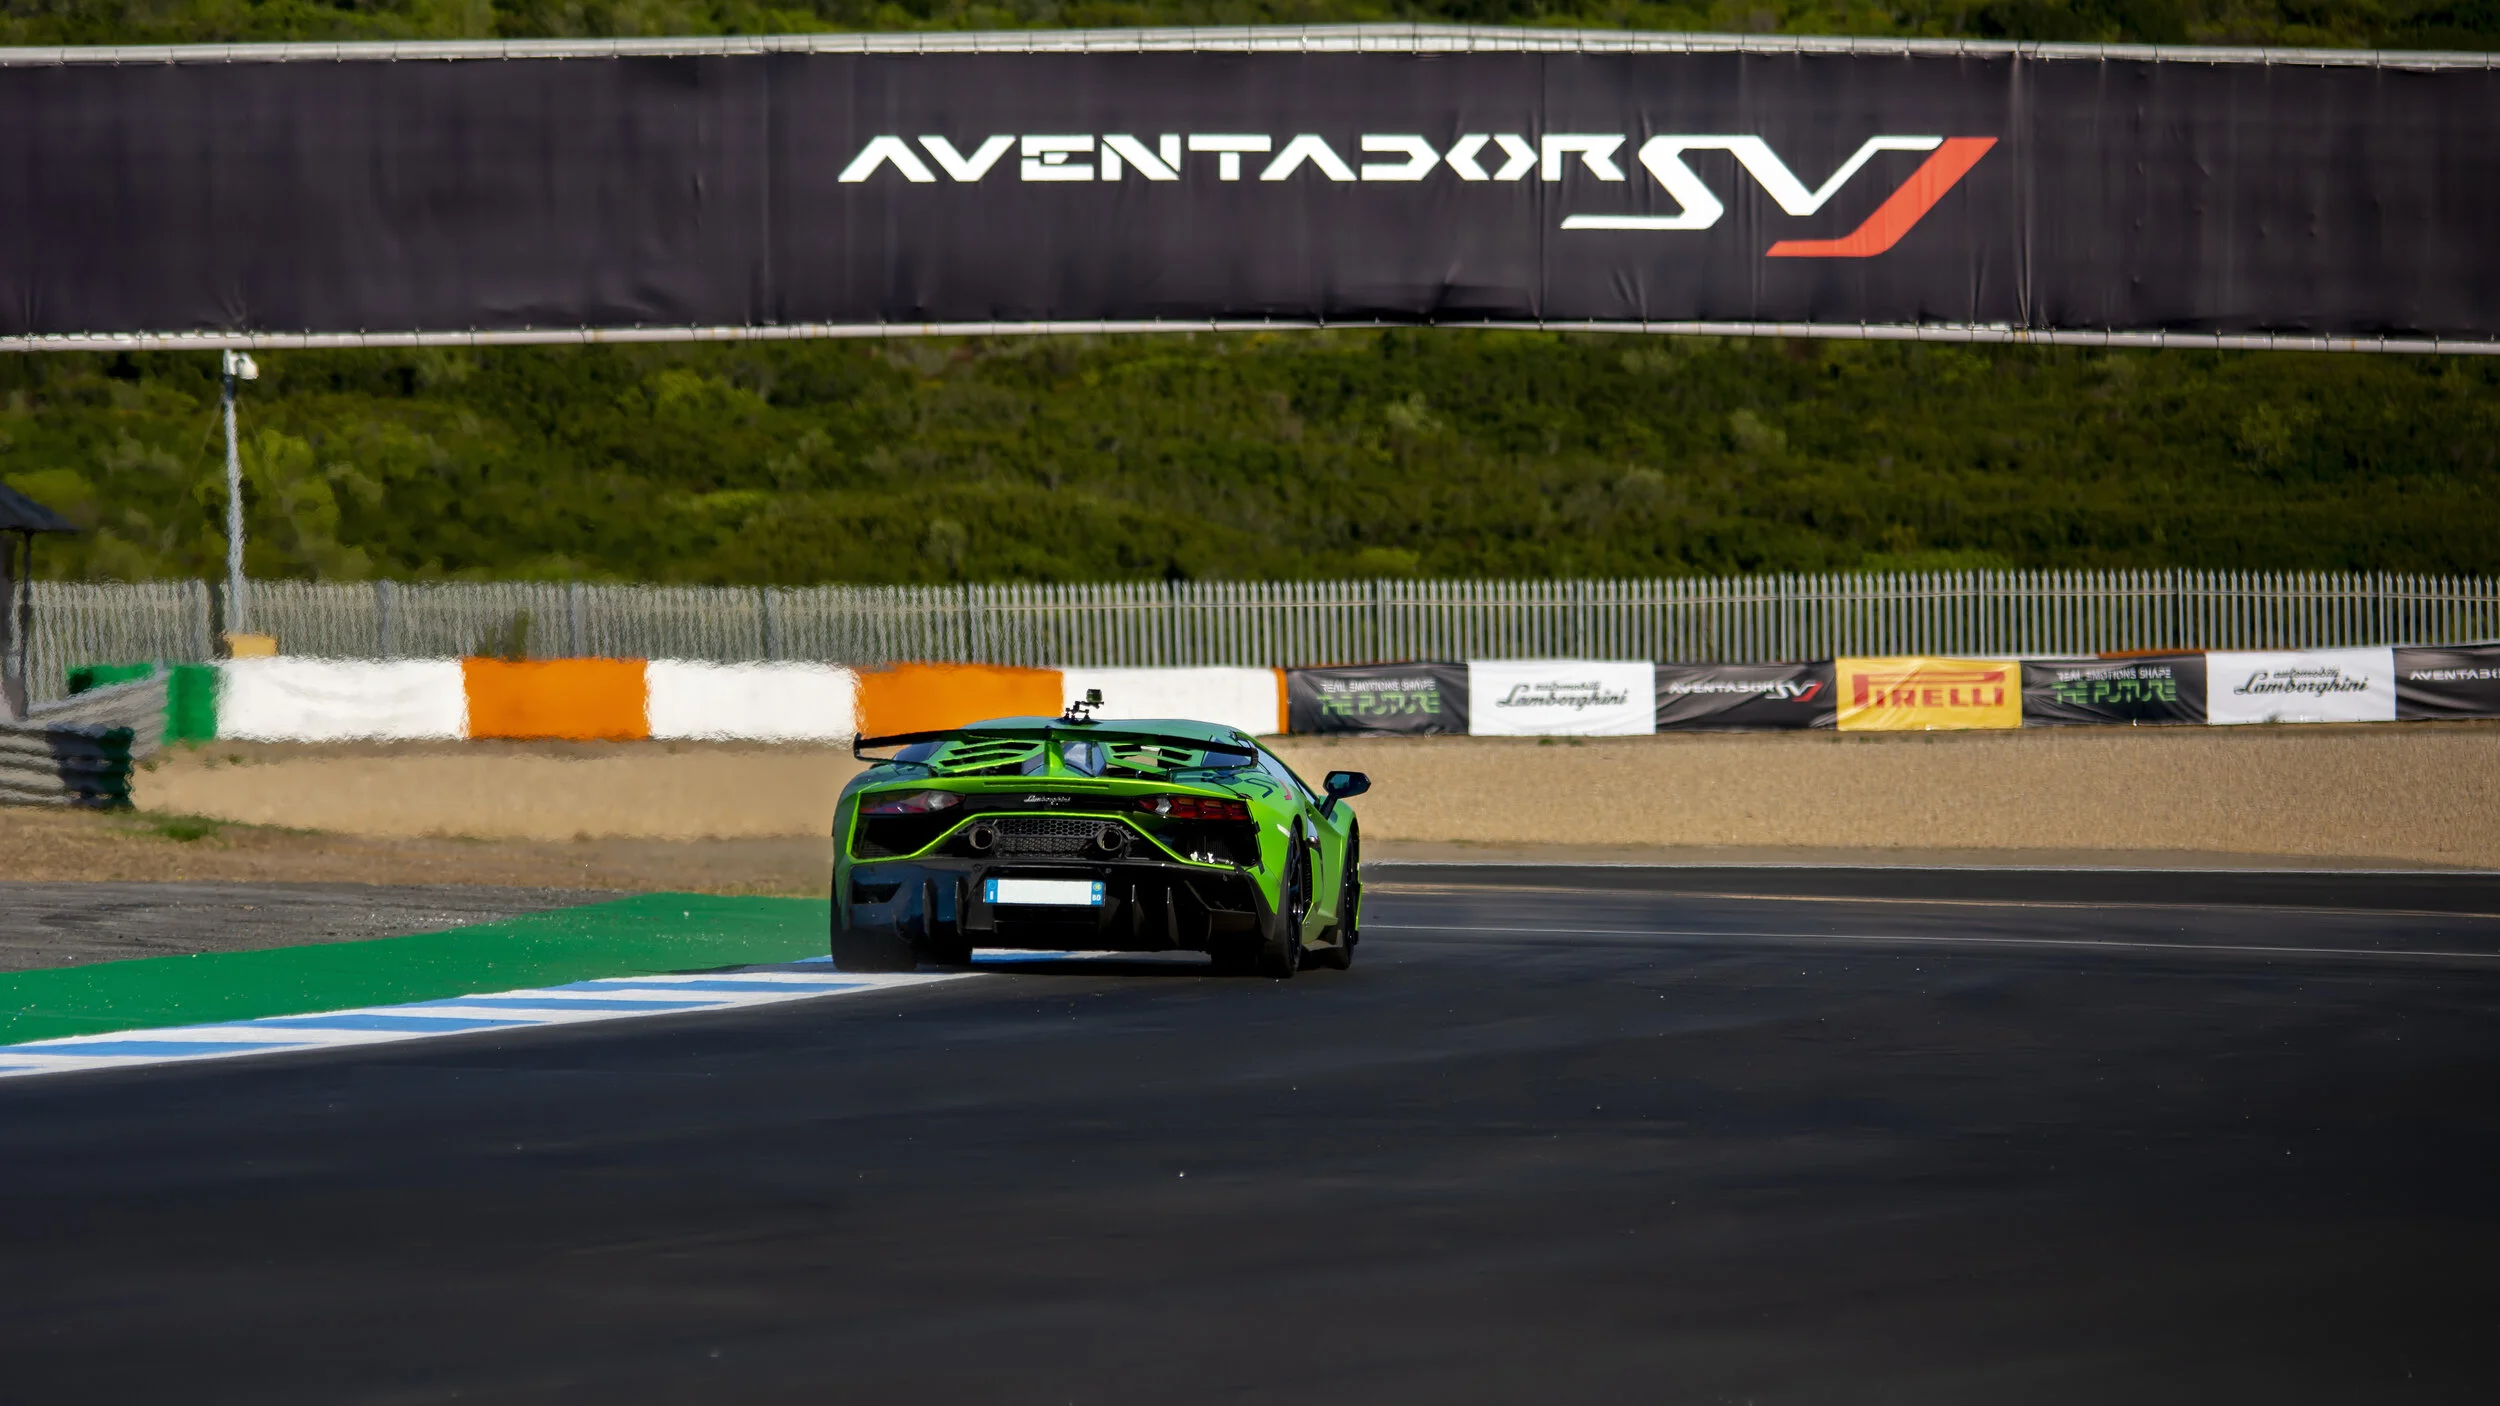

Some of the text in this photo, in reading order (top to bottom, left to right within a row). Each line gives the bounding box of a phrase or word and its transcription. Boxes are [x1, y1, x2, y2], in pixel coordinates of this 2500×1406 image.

[838, 134, 1998, 257] AVENTADOR SVJ
[2085, 668, 2137, 681] EMOTIONS
[2139, 665, 2172, 680] SHAPE
[2233, 670, 2369, 697] Lamborghini
[1496, 684, 1629, 711] Lamborghini
[1668, 680, 1823, 702] AVENTADOR SVJ
[1852, 671, 2006, 708] PIRELLI
[2094, 680, 2177, 703] FUTURE
